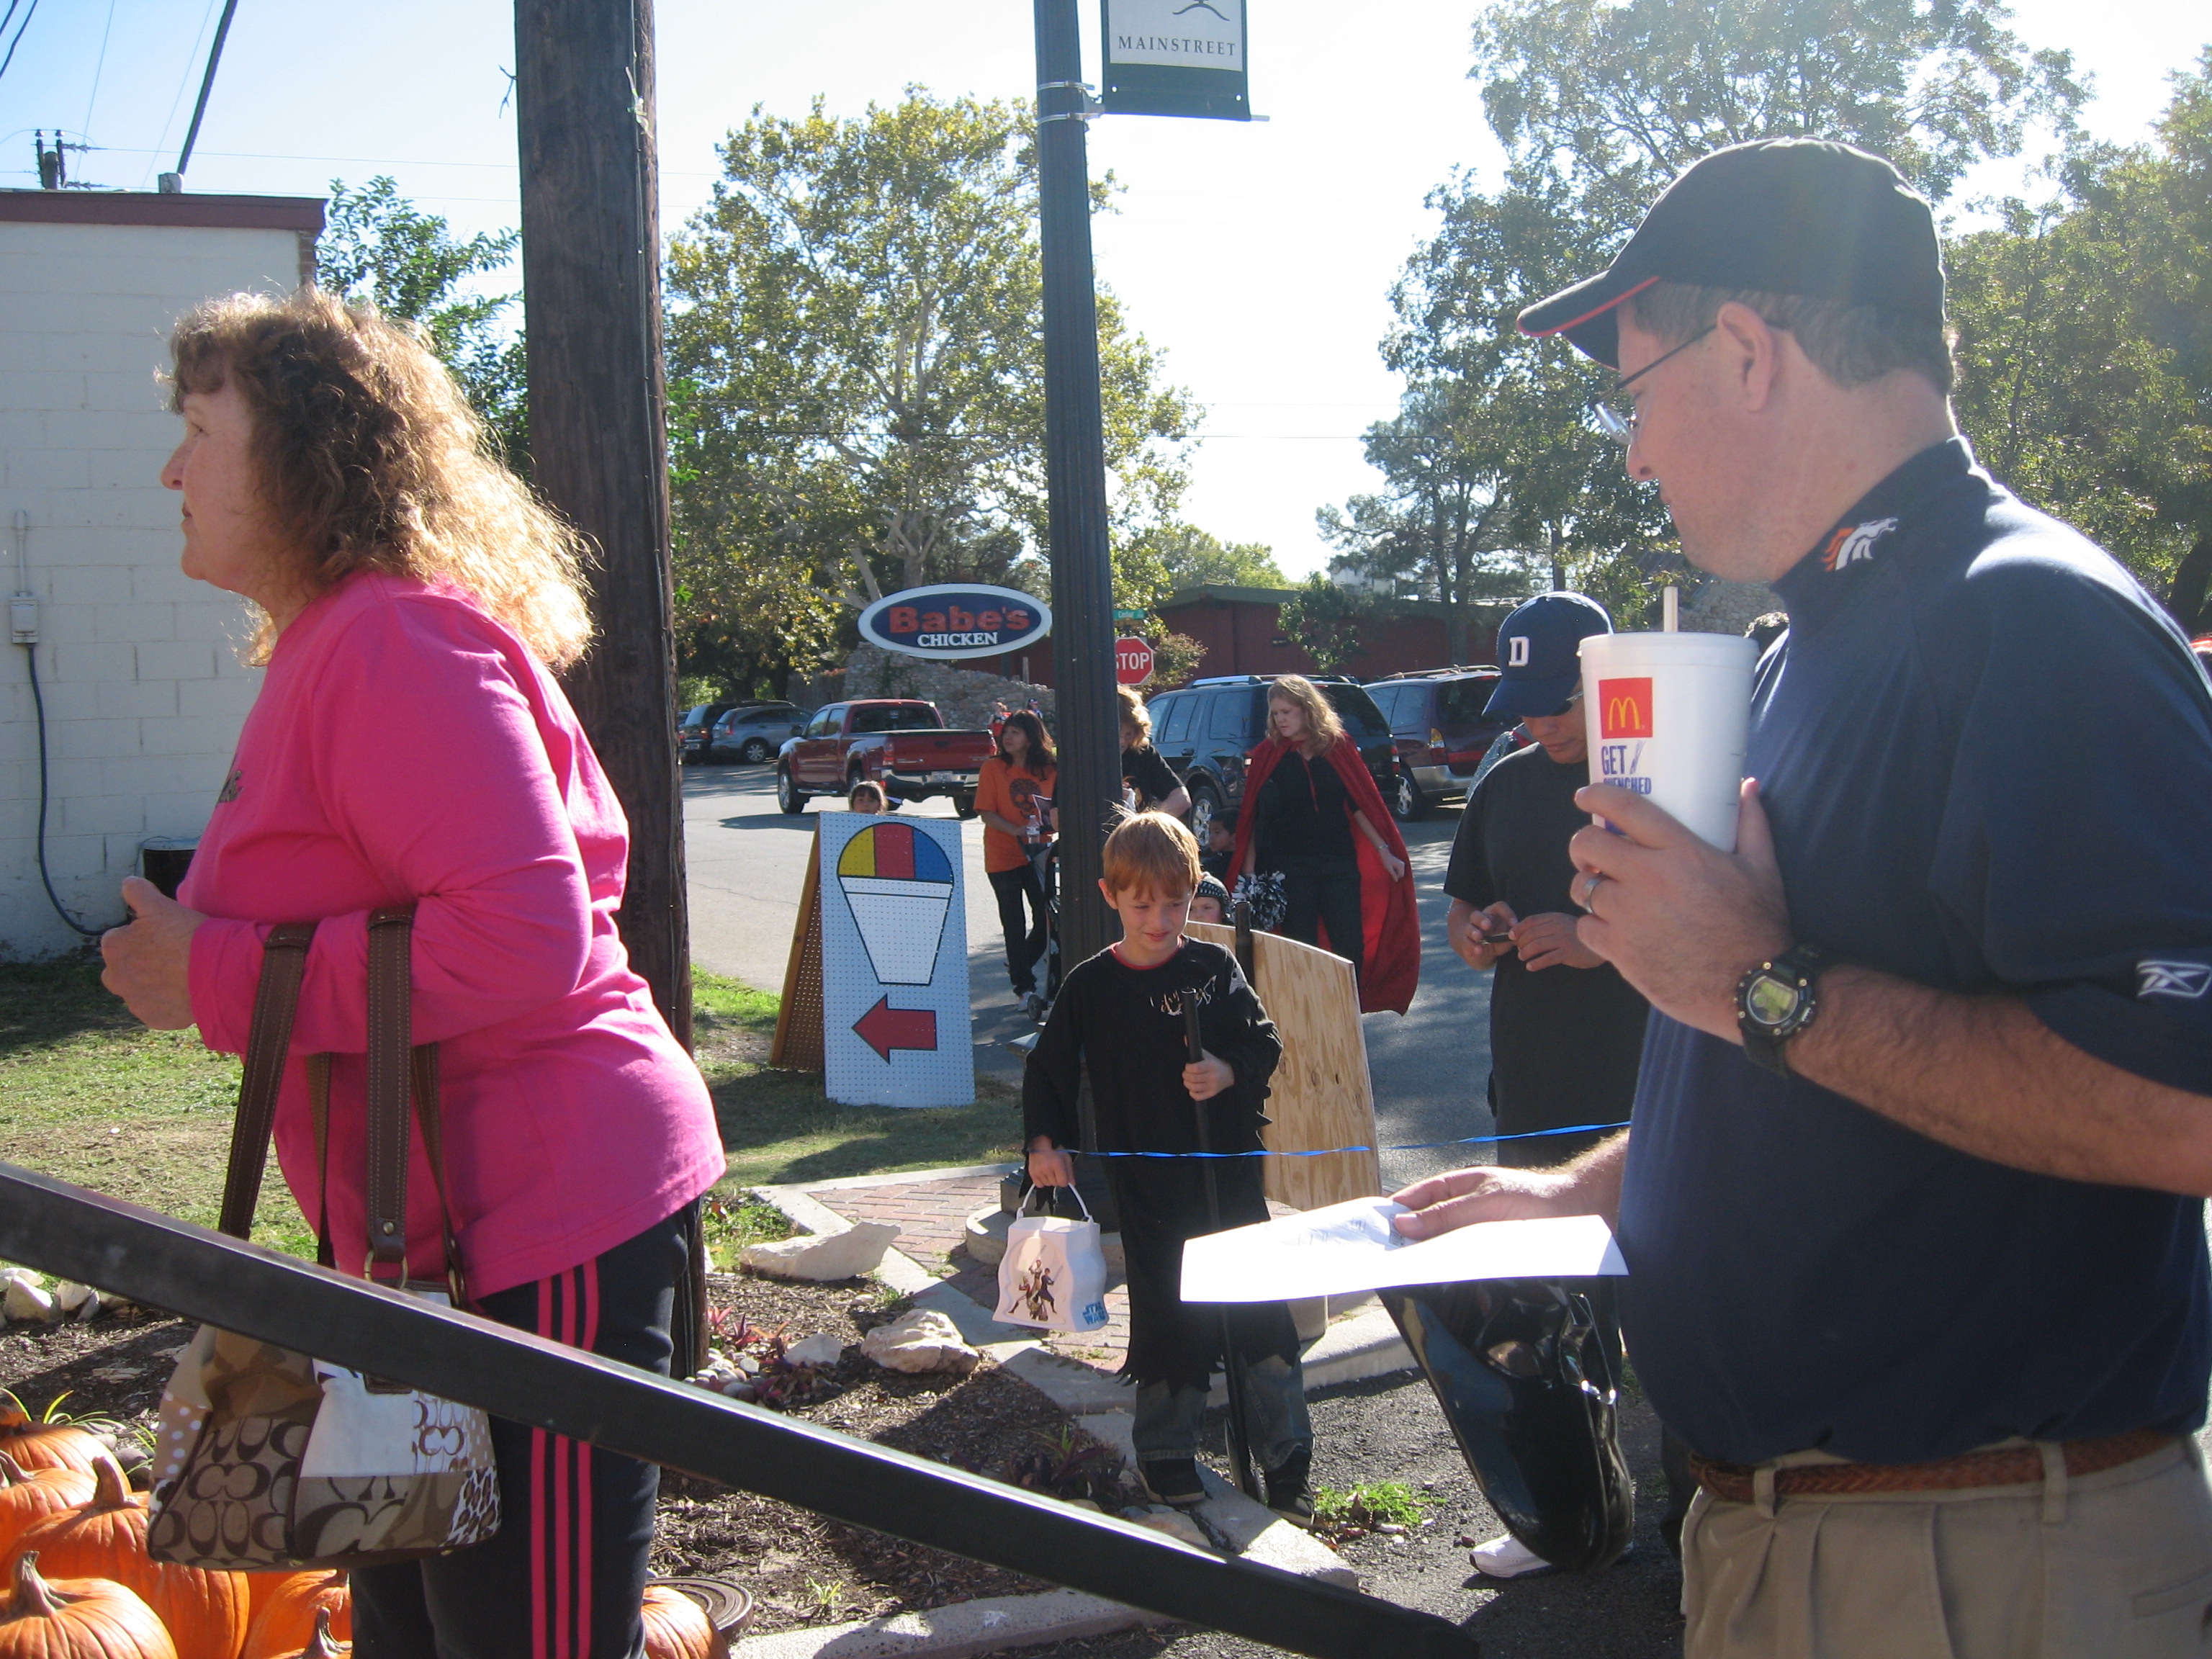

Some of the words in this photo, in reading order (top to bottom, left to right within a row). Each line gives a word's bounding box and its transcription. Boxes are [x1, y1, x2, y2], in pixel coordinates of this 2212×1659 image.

[1118, 35, 1236, 56] MAINSTREET
[889, 606, 1030, 633] Babe's
[917, 632, 998, 647] CHICKEN
[1509, 636, 1529, 667] D
[1601, 745, 1627, 775] GET
[1604, 777, 1652, 795] NCHED
